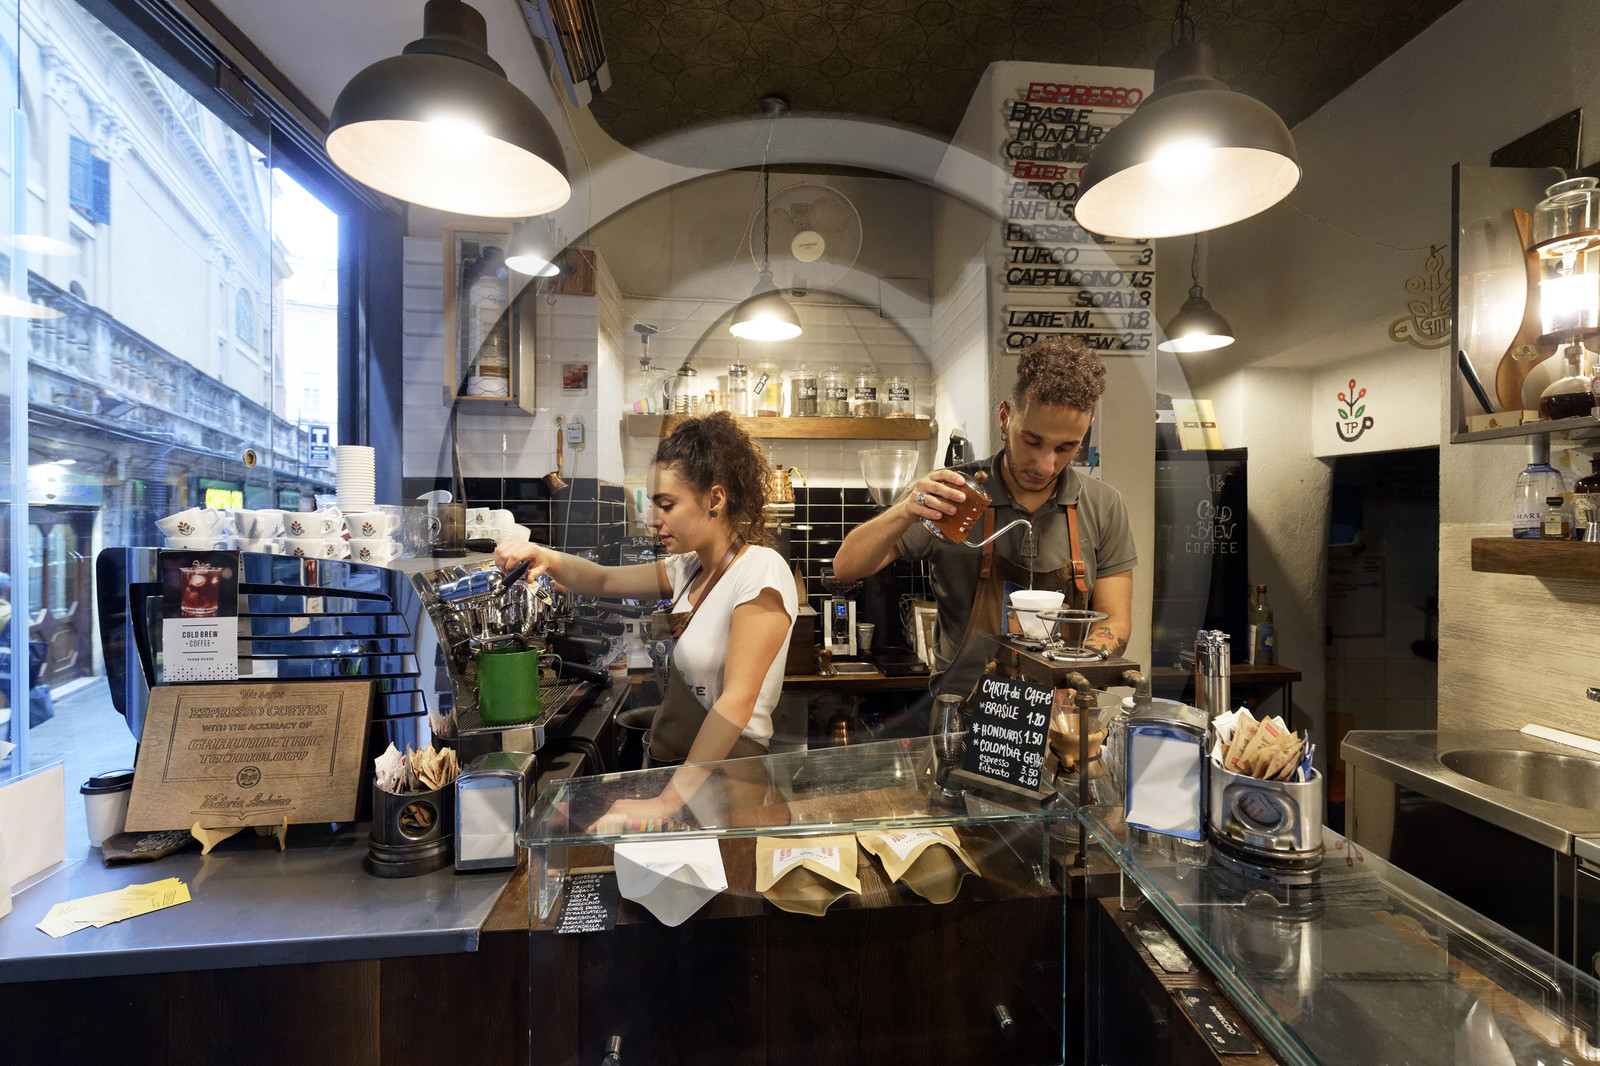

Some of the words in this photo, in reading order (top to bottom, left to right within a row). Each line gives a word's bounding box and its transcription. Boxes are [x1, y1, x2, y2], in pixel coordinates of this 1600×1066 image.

[1025, 82, 1143, 108] ESPRESSO
[1009, 101, 1093, 124] BRASILE
[1016, 122, 1106, 144] HONDUR
[1008, 181, 1079, 200] PERCO
[1008, 199, 1075, 220] INFUS
[1006, 223, 1091, 244] PRESSIO
[1010, 246, 1079, 264] TURCO
[1138, 248, 1153, 265] 3
[1129, 270, 1155, 288] 1.5
[1129, 291, 1151, 309] 1.8
[1071, 310, 1095, 328] M.
[1127, 311, 1150, 330] 1.8
[1120, 332, 1152, 350] 2.5
[1344, 421, 1358, 434] TP
[312, 428, 327, 447] T
[1196, 499, 1232, 523] COLD
[1190, 520, 1237, 542] BREW
[1185, 541, 1238, 554] COFFEE
[182, 631, 199, 639] COLD
[200, 630, 218, 638] BREW
[189, 639, 211, 648] COFFEE
[239, 688, 257, 700] We
[257, 689, 284, 700] serve
[982, 679, 1011, 700] CARTA
[189, 705, 264, 719] ESPRESSO
[266, 703, 328, 717] COFFEE
[1026, 711, 1046, 727] 1.20
[201, 723, 227, 731] WITH
[228, 723, 246, 731] THE
[248, 721, 297, 731] ACCURACY
[298, 720, 312, 729] OF
[188, 734, 323, 751] GRAVIMETRIC
[981, 724, 1023, 745] HONDURAS
[1023, 730, 1044, 746] 1.50
[199, 750, 309, 764] TECHNOLOGY
[979, 754, 1010, 768] espresso
[1020, 765, 1039, 777] 3.50
[978, 762, 1010, 778] filtrato
[200, 793, 245, 810] Victoria
[246, 792, 292, 808] Arduino
